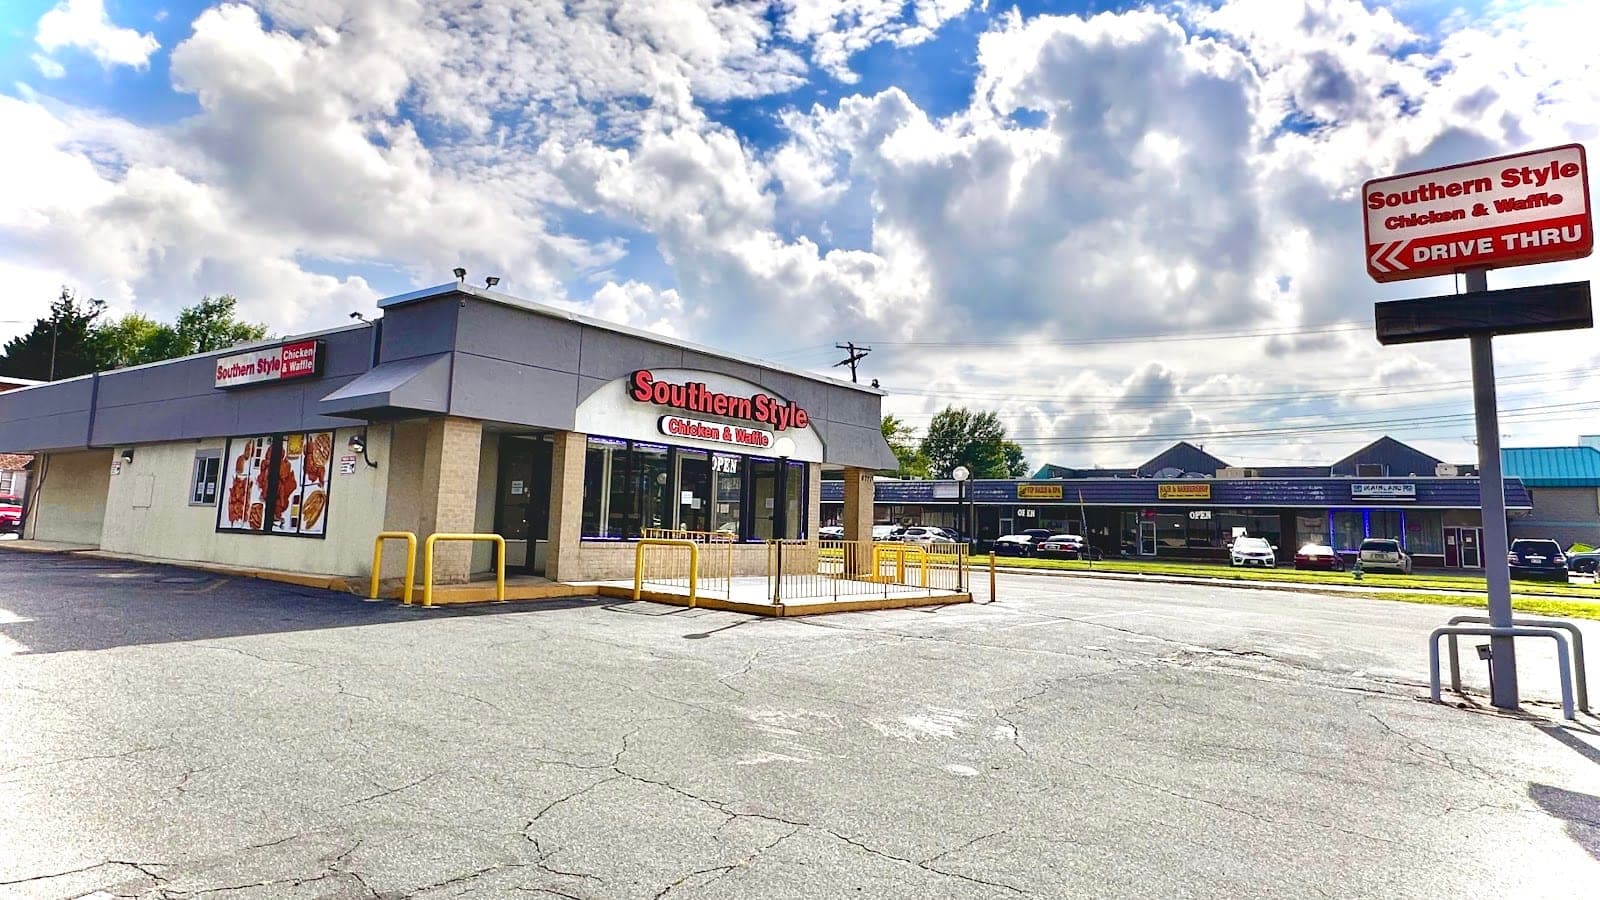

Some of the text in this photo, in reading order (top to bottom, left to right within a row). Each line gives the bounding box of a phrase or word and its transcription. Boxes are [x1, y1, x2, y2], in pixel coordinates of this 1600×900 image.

[1368, 160, 1580, 209] Southern Style
[1385, 192, 1563, 230] Chicken & Waffle
[1413, 225, 1582, 262] DRIVE THRU
[281, 360, 313, 373] & Waffle
[283, 348, 313, 361] Chicken
[217, 356, 280, 380] Southern Style
[630, 370, 808, 431] Southern Style
[668, 418, 769, 447] Chicken & Waffle
[711, 455, 738, 474] OPEN
[1189, 510, 1212, 520] OPEN
